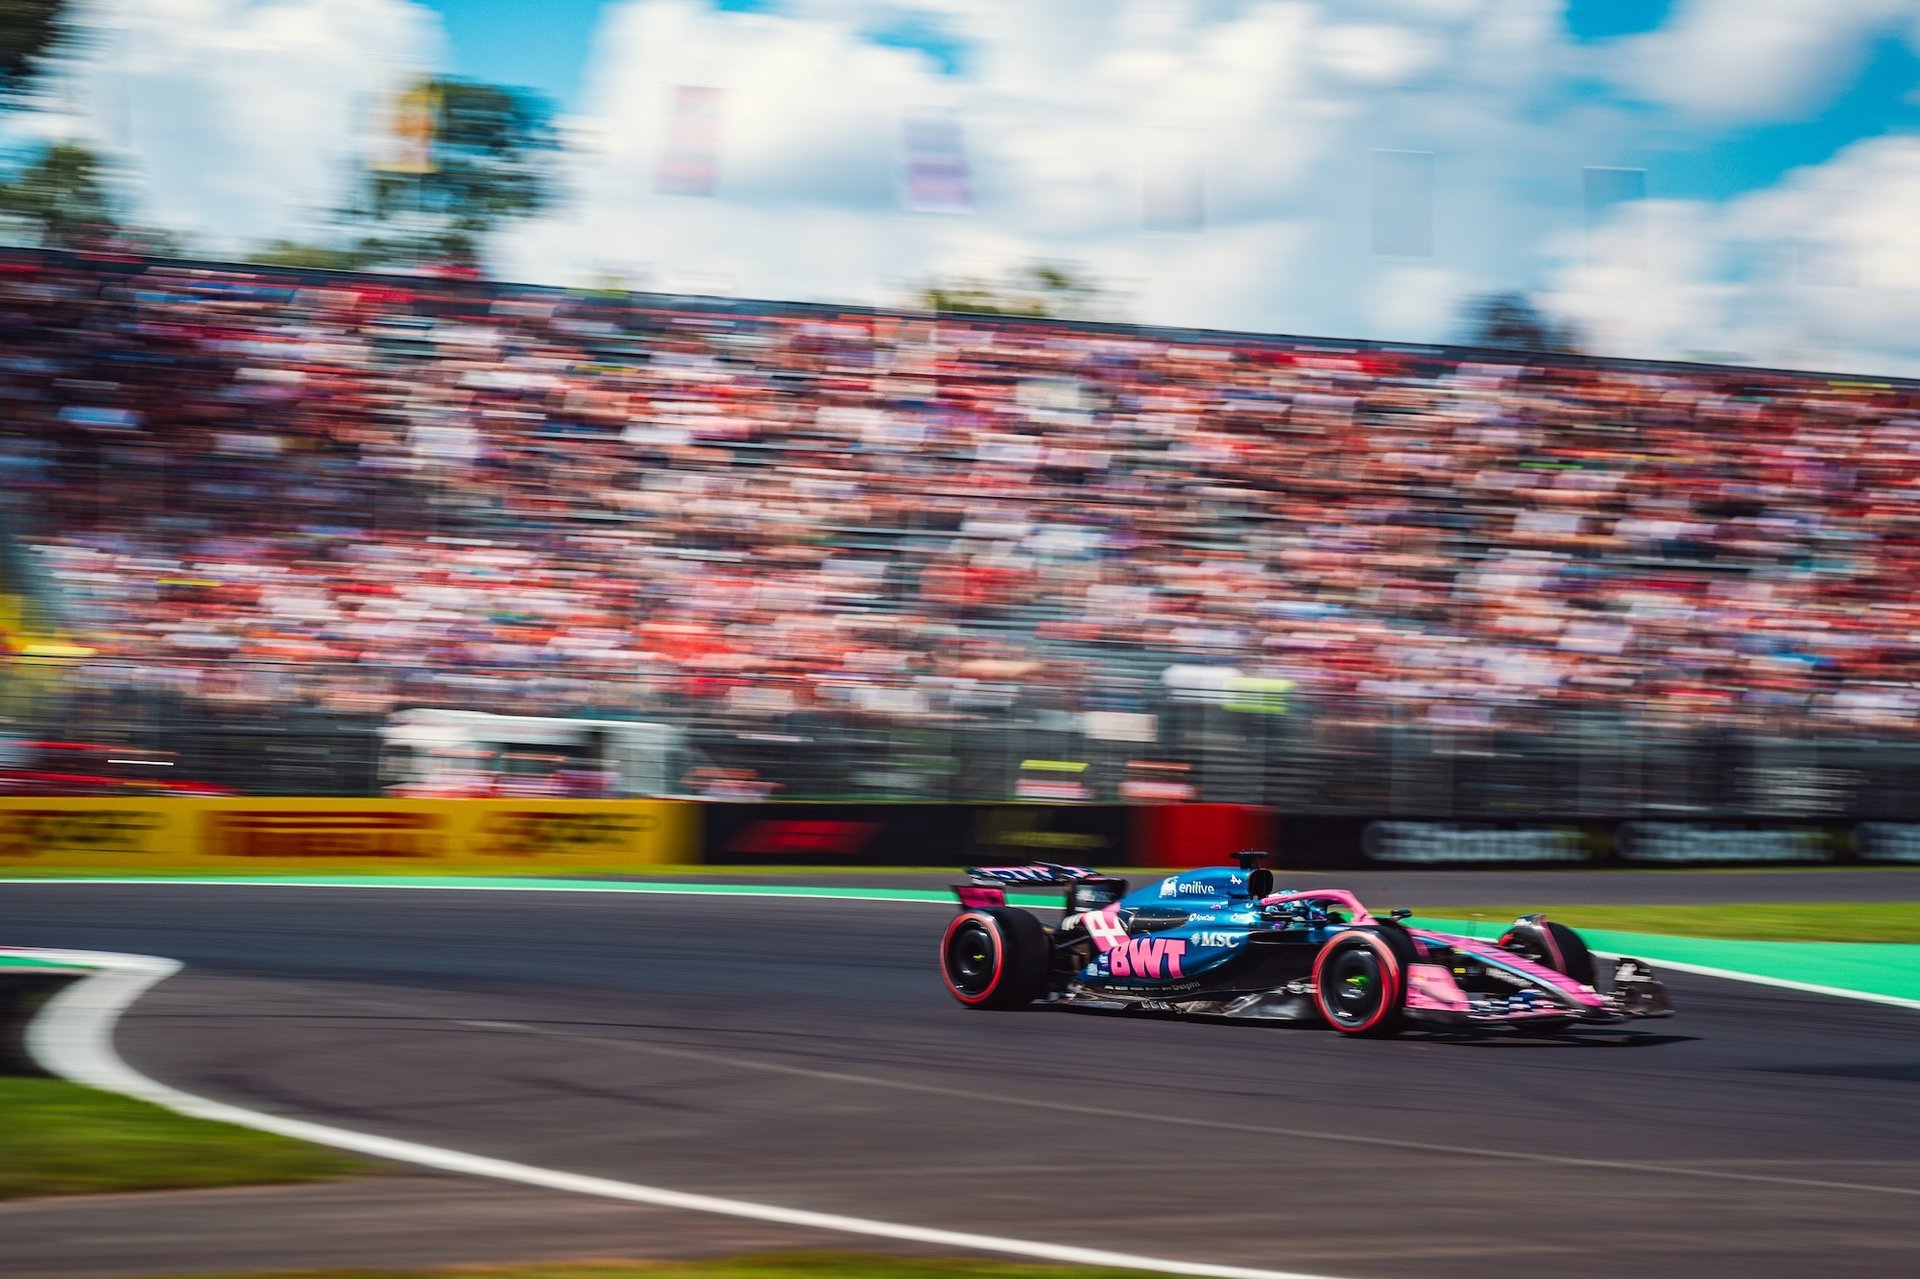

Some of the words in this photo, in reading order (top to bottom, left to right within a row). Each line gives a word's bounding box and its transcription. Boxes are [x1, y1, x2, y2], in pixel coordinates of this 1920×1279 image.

[1179, 881, 1215, 895] enilive
[1200, 931, 1240, 949] MSC
[1110, 938, 1186, 979] BWT
[1171, 981, 1200, 991] Delphi
